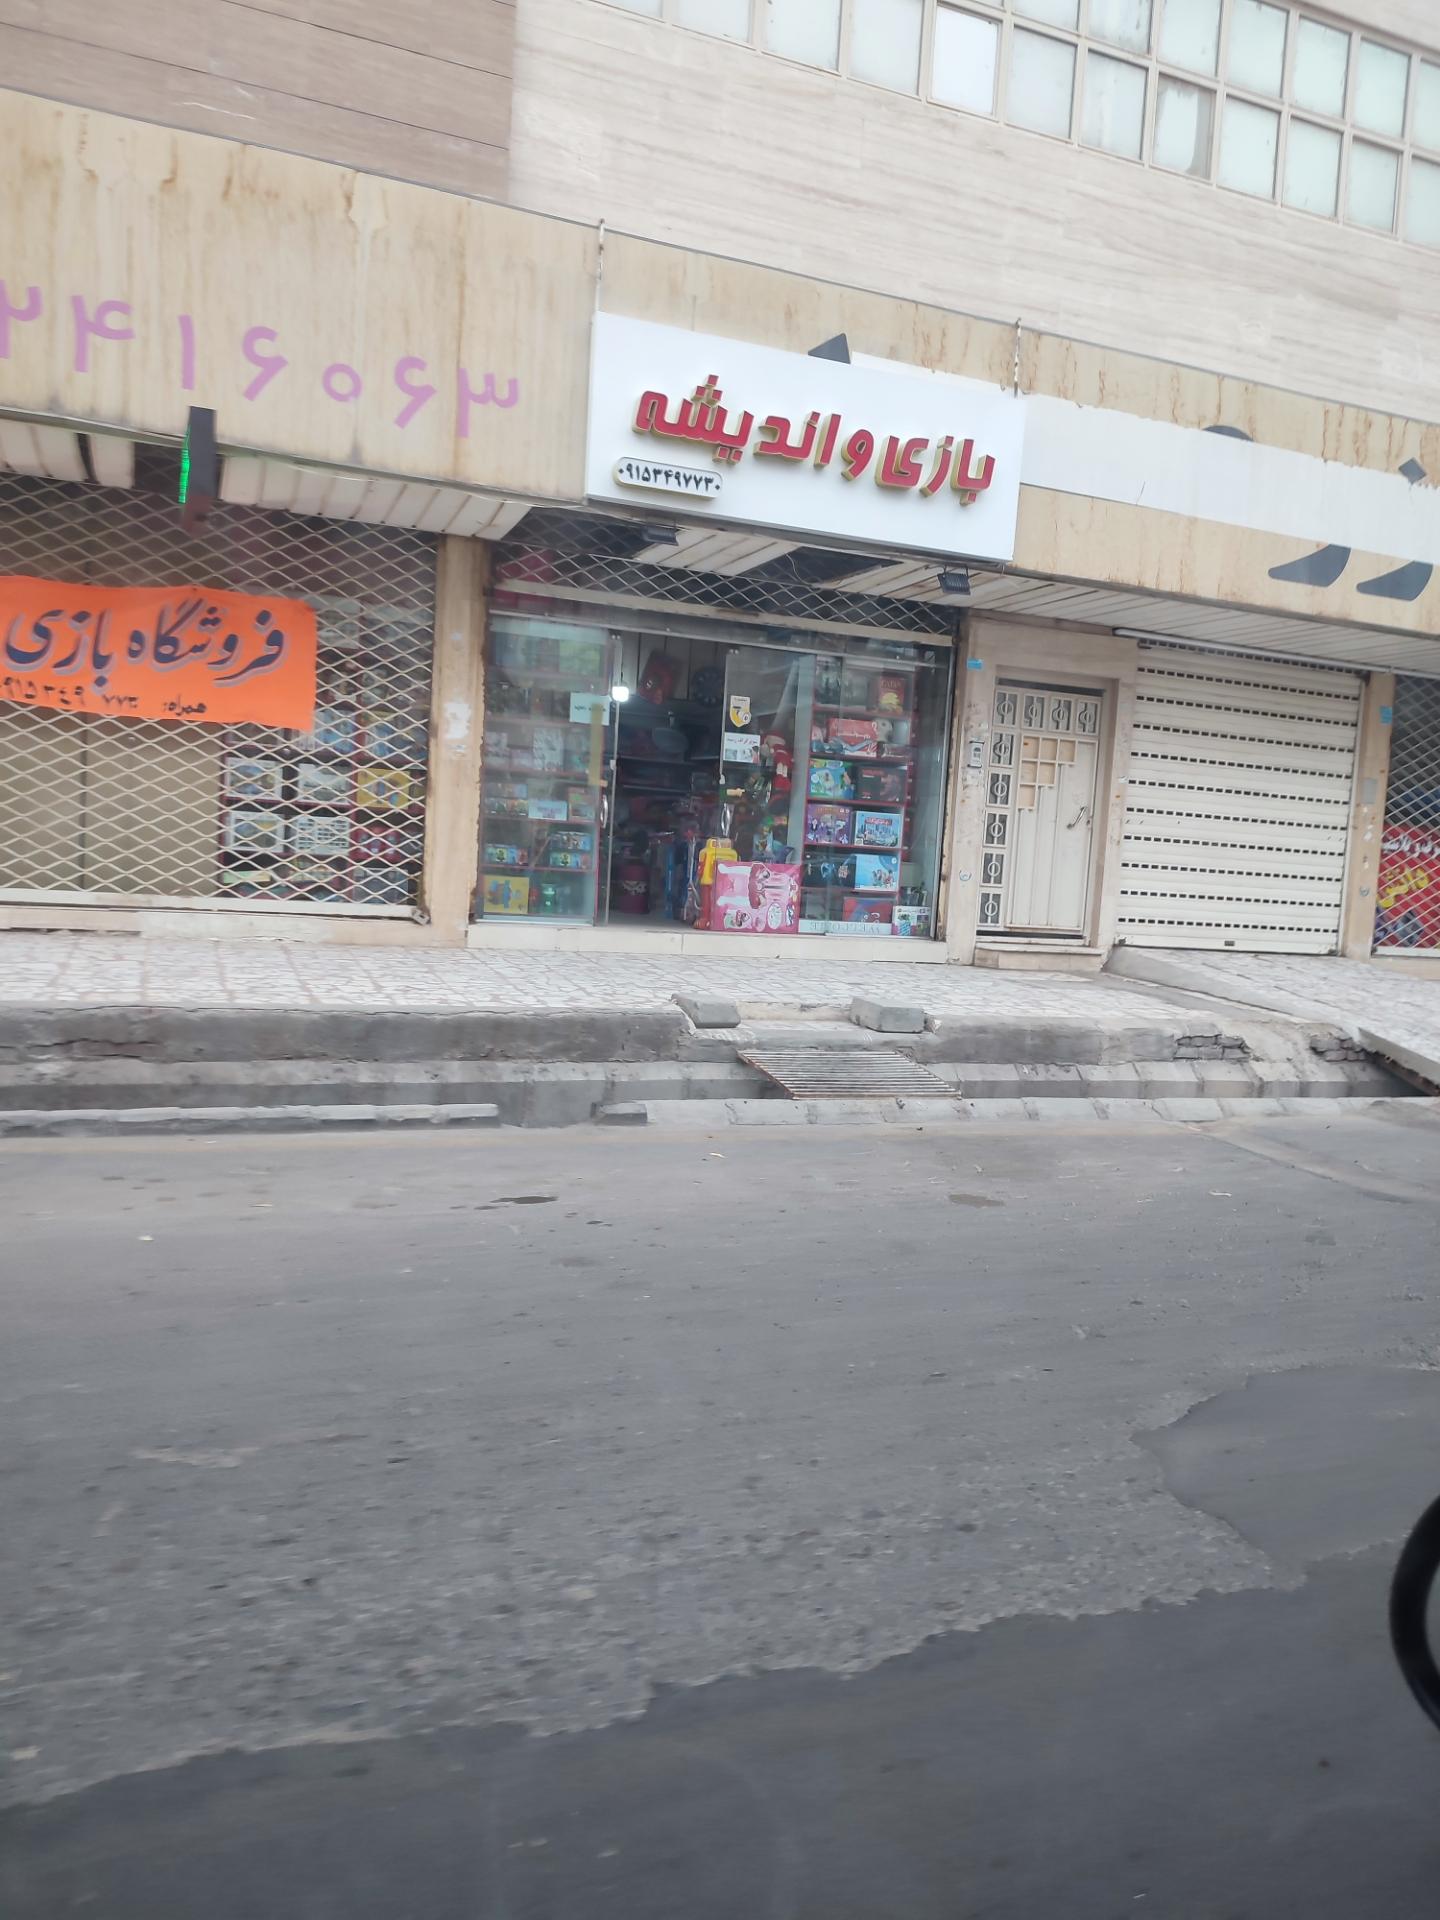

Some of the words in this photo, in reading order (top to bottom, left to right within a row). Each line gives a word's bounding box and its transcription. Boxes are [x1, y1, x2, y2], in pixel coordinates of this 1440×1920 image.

[633, 374, 842, 467] اندیشه
[841, 428, 875, 481] و
[618, 462, 721, 492] ۰۹۱۵۳۴۹۷۷۳۰
[876, 435, 996, 506] بازی
[4, 606, 117, 691] بازی
[127, 597, 290, 686] فروشگاه
